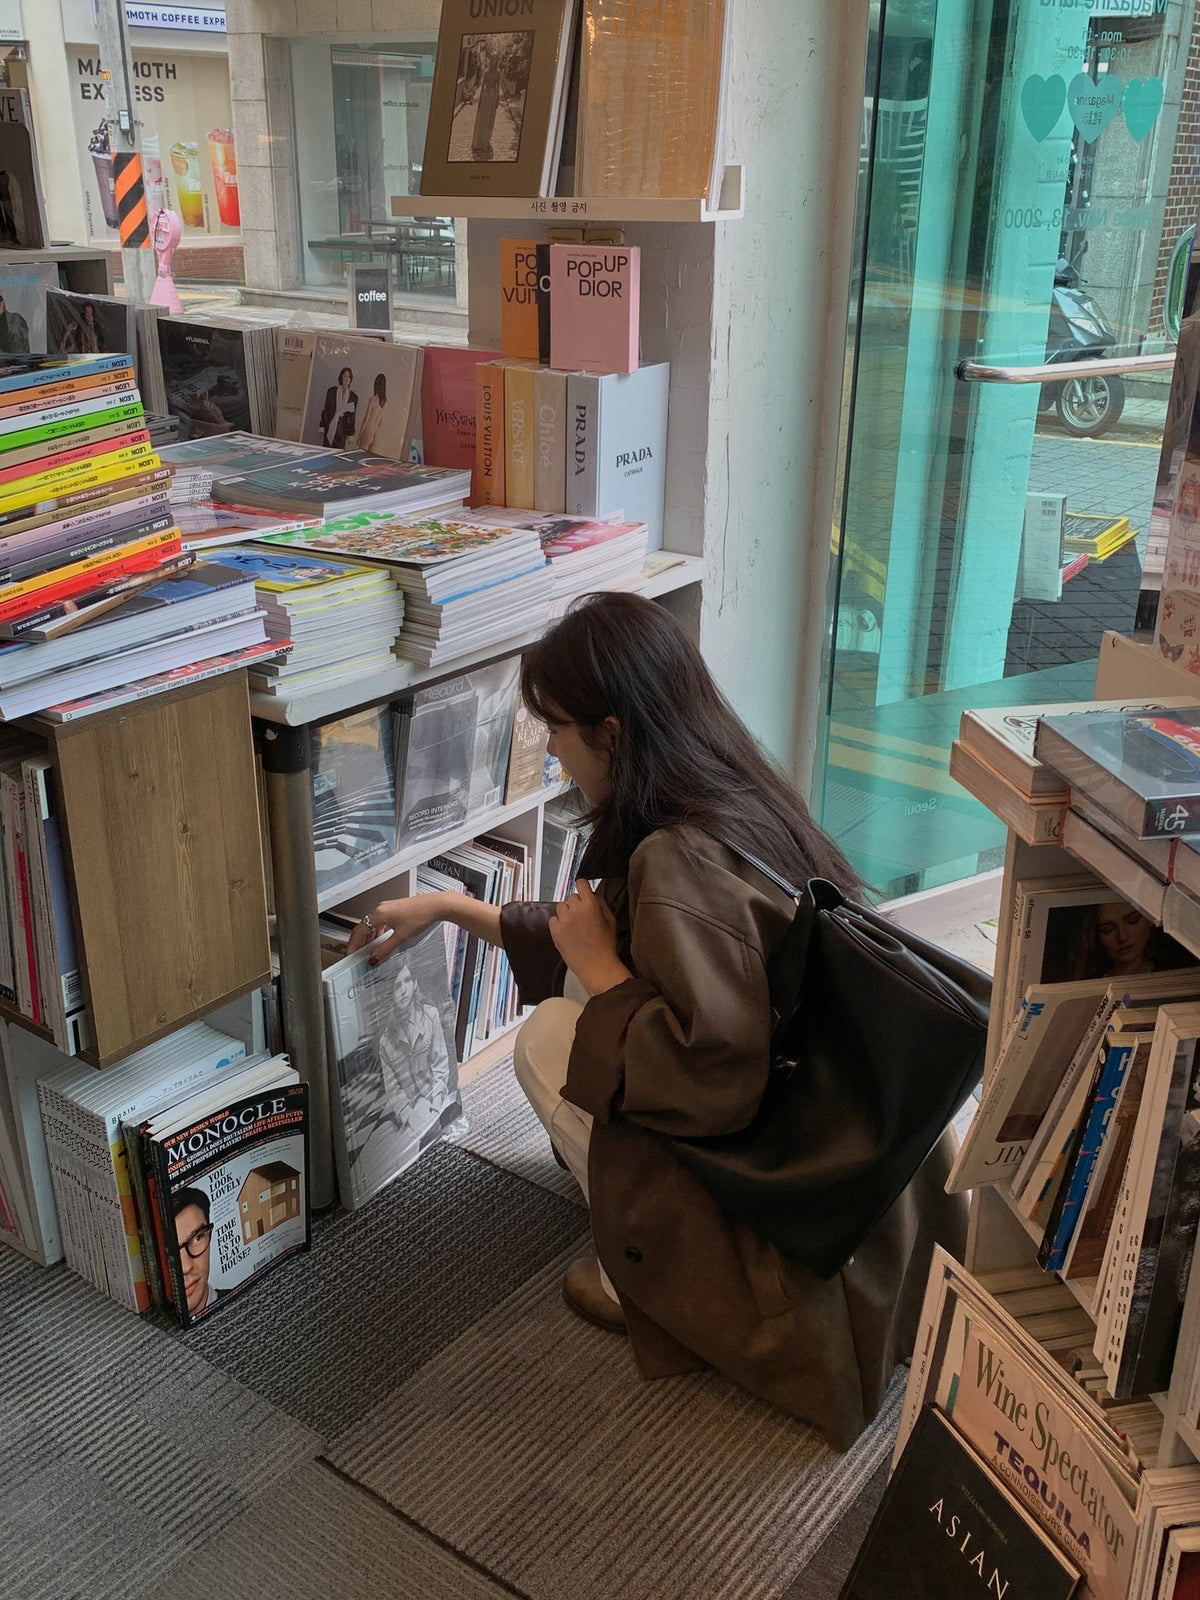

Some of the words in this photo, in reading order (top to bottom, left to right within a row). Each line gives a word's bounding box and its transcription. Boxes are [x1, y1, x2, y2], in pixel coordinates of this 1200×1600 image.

[161, 13, 200, 24] COFFEE
[530, 202, 546, 212] 사진
[551, 202, 567, 212] 촬영
[571, 202, 587, 213] 금지
[358, 290, 387, 302] coffee
[579, 279, 622, 298] DIOR
[483, 384, 492, 421] LOUIS
[512, 399, 525, 465] VERSACE
[539, 404, 556, 468] Chloé
[574, 404, 587, 477] PRADA
[483, 426, 492, 477] VUITTON
[616, 446, 653, 469] PRADA
[424, 679, 464, 701] Record
[408, 808, 430, 822] RECORD
[167, 1097, 287, 1166] MONOCLE
[223, 1124, 253, 1144] BRUTALISM
[219, 1137, 242, 1154] PLAYERS
[208, 1166, 226, 1182] YOU
[209, 1172, 233, 1193] LOOK
[211, 1176, 242, 1203] LOVELY
[216, 1217, 237, 1237] TIME
[217, 1230, 234, 1247] FOR
[219, 1243, 229, 1256] US
[230, 1234, 241, 1248] TO
[220, 1245, 240, 1265] PLAY
[221, 1247, 252, 1274] HOUSE?
[977, 1338, 1028, 1432] Wine
[1029, 1402, 1124, 1561] Spectator
[994, 1430, 1092, 1561] TEQUILA
[928, 1498, 1010, 1600] ASIAN
